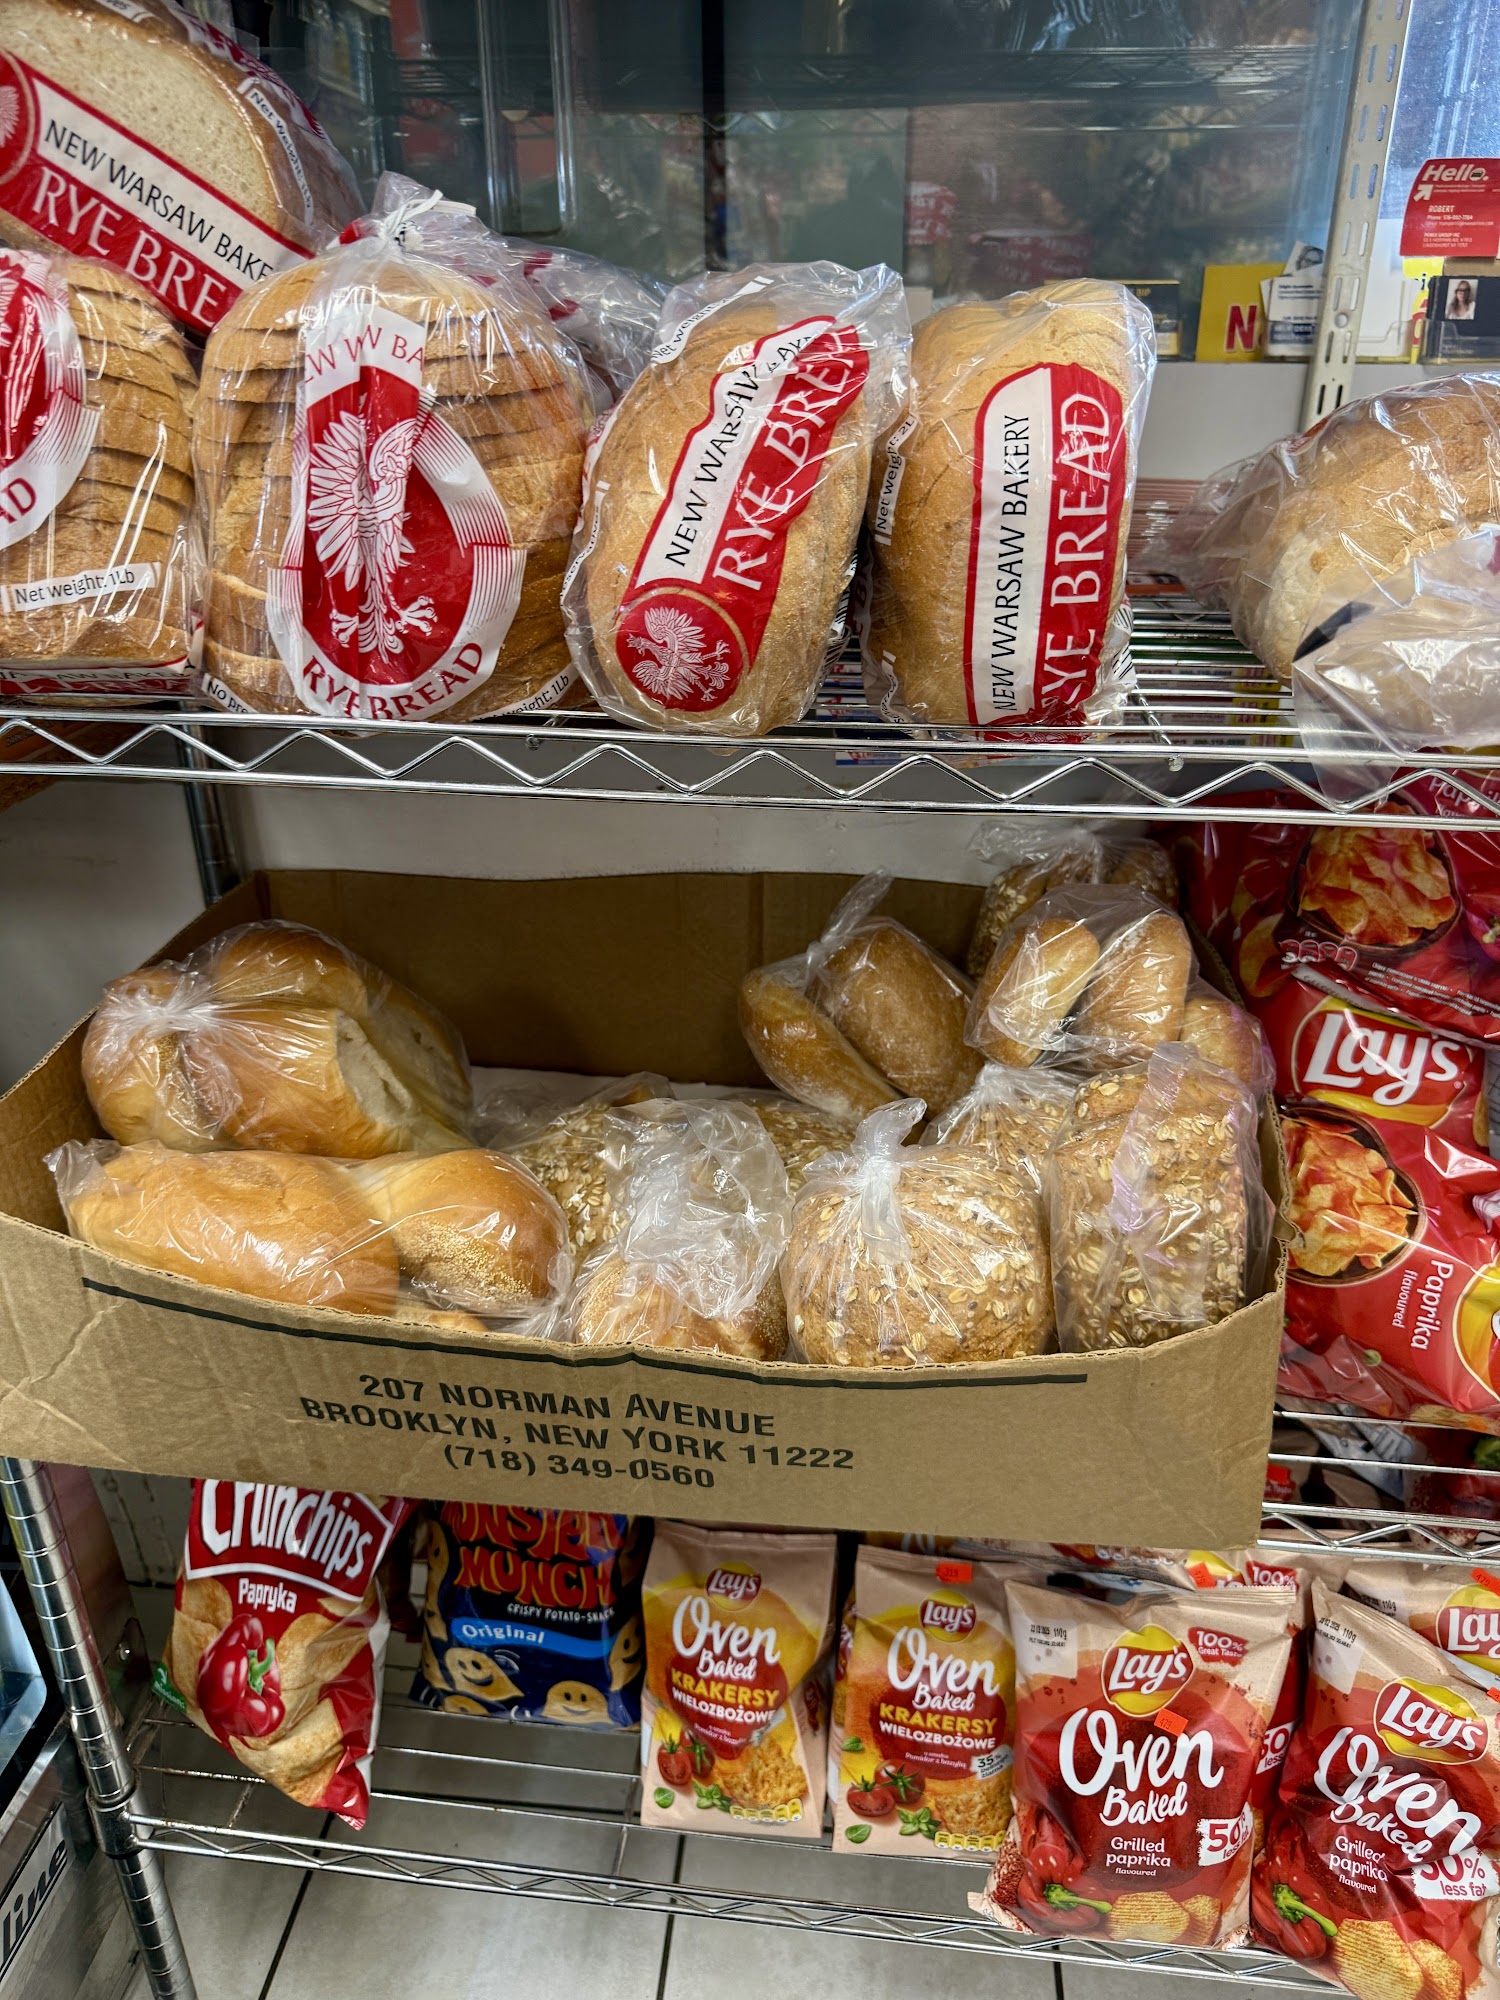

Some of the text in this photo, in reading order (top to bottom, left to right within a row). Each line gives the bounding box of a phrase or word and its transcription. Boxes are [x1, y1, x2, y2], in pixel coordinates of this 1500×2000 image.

[44, 118, 107, 172] NEW
[108, 156, 216, 245] WARSAW
[1422, 164, 1489, 182] Hello.
[32, 165, 123, 256] RYE
[876, 498, 891, 531] Net
[1049, 392, 1112, 609] BREAD
[665, 488, 707, 568] NEW
[712, 471, 796, 592] RYE
[991, 414, 1030, 712] NEW WARSAW BAKERY
[14, 584, 45, 605] Net
[47, 570, 108, 598] weight:
[207, 680, 227, 700] No
[366, 641, 484, 721] BREAD
[1303, 1012, 1461, 1107] Lay's
[1391, 1269, 1419, 1329] flavoured
[1410, 1259, 1455, 1351] Paprika
[358, 1374, 776, 1438] 207 NORMAN AVENUE
[301, 1396, 855, 1471] BROOKLYN, NEW YORK 11222
[443, 1443, 716, 1489] (718) 349-0560
[201, 1478, 374, 1580] Crunchips
[237, 1576, 298, 1614] Papryka
[453, 1545, 618, 1610] MUNCH
[506, 1602, 543, 1619] CRISPY
[672, 1593, 782, 1666] Oven
[923, 1600, 975, 1632] Lay's
[461, 1623, 546, 1645] Original
[1196, 1630, 1245, 1651] 100%
[1197, 1646, 1220, 1657] Great
[696, 1647, 758, 1680] Baked
[886, 1625, 1001, 1697] Oven
[1108, 1645, 1189, 1695] Lay's
[670, 1667, 780, 1708] KRAKERSY
[911, 1681, 977, 1712] Baked
[878, 1720, 997, 1750] WIELOZBOŻOWE
[879, 1702, 998, 1736] KRAKERSY
[1379, 1685, 1484, 1751] Lay's
[1059, 1707, 1225, 1797] Oven
[1099, 1780, 1189, 1827] Baked
[1313, 1726, 1482, 1856] Oven
[1110, 1836, 1165, 1854] Grilled
[1329, 1795, 1434, 1863] Baked
[1334, 1834, 1386, 1865] Grilled
[1105, 1852, 1172, 1868] paprika
[1114, 1867, 1157, 1878] flavoured
[1328, 1852, 1389, 1883] paprika
[1337, 1872, 1378, 1895] flavoured
[1439, 1880, 1488, 1898] less fat
